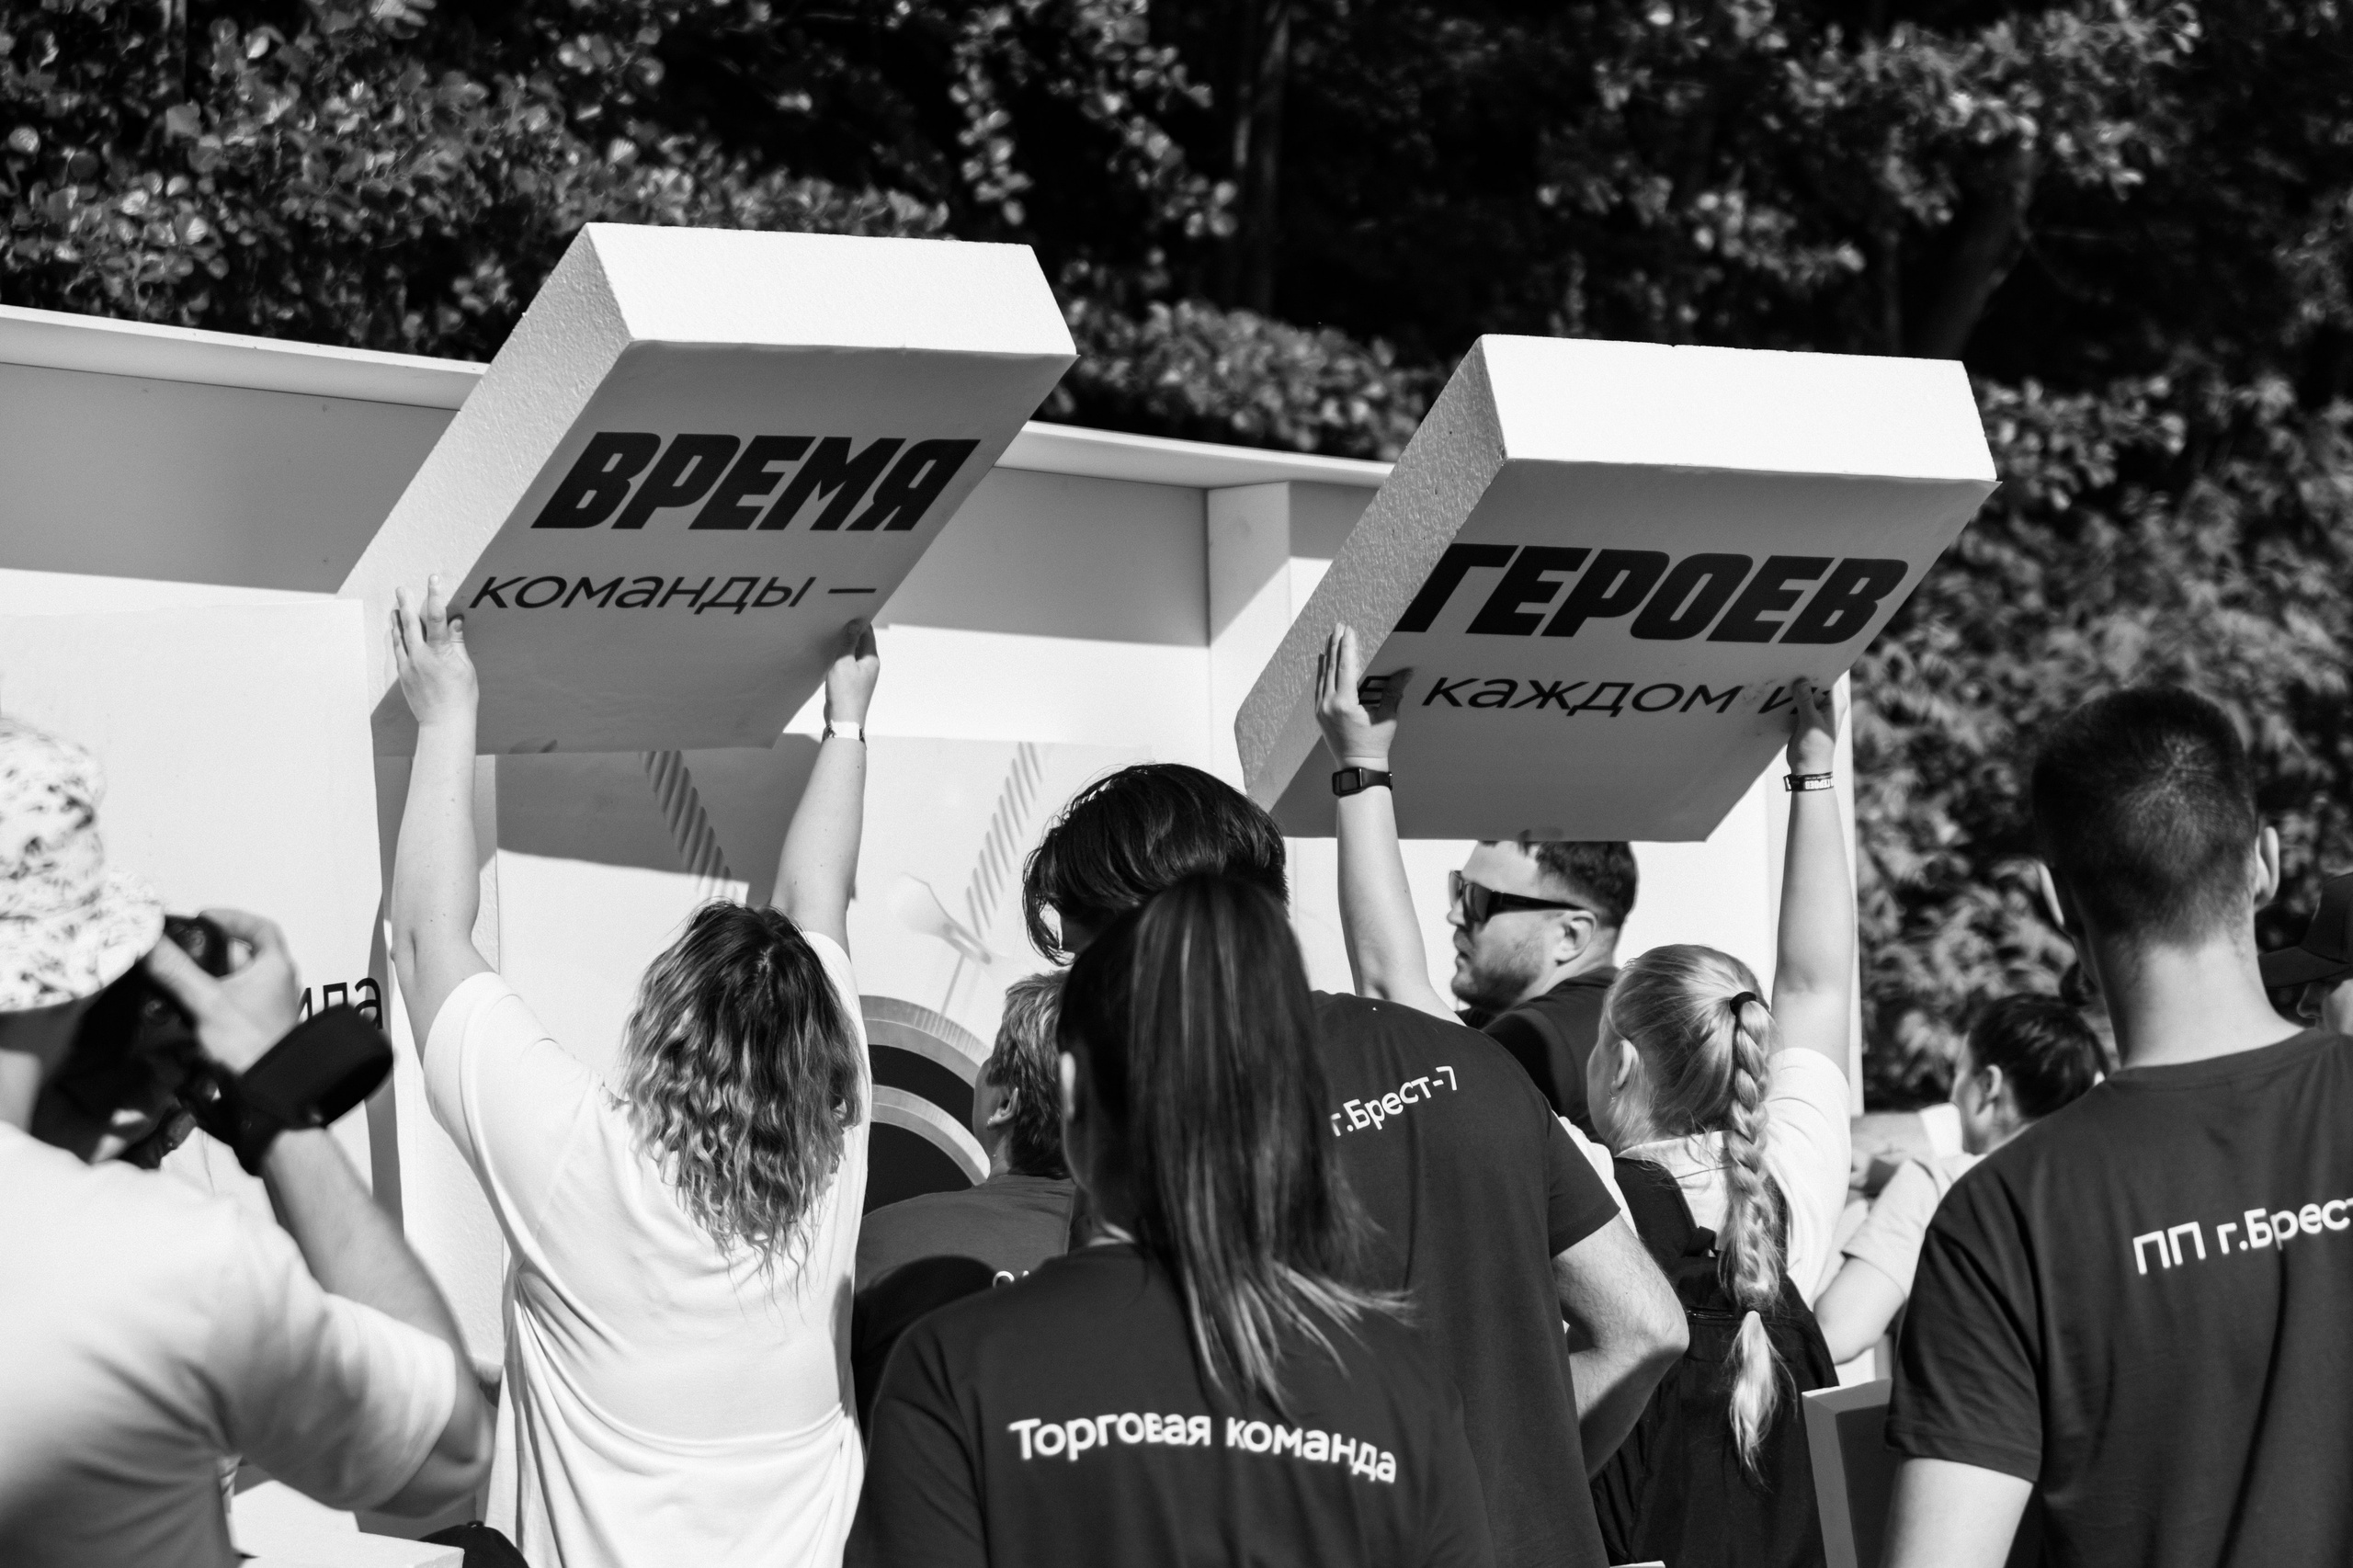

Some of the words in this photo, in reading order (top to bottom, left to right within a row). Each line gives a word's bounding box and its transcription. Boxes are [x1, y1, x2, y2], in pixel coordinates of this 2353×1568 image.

[530, 431, 981, 531] ВРЕМЯ
[469, 575, 817, 616] команды
[1392, 542, 1909, 644] ГЕРОЕВ
[1421, 676, 1745, 718] каждом
[1757, 686, 1831, 715] и
[1330, 1065, 1458, 1137] г.Брест-7
[2132, 1221, 2207, 1276] ПП
[2216, 1197, 2353, 1256] г.Брес
[1007, 1411, 1211, 1461] Торговая
[1225, 1415, 1397, 1483] команда
